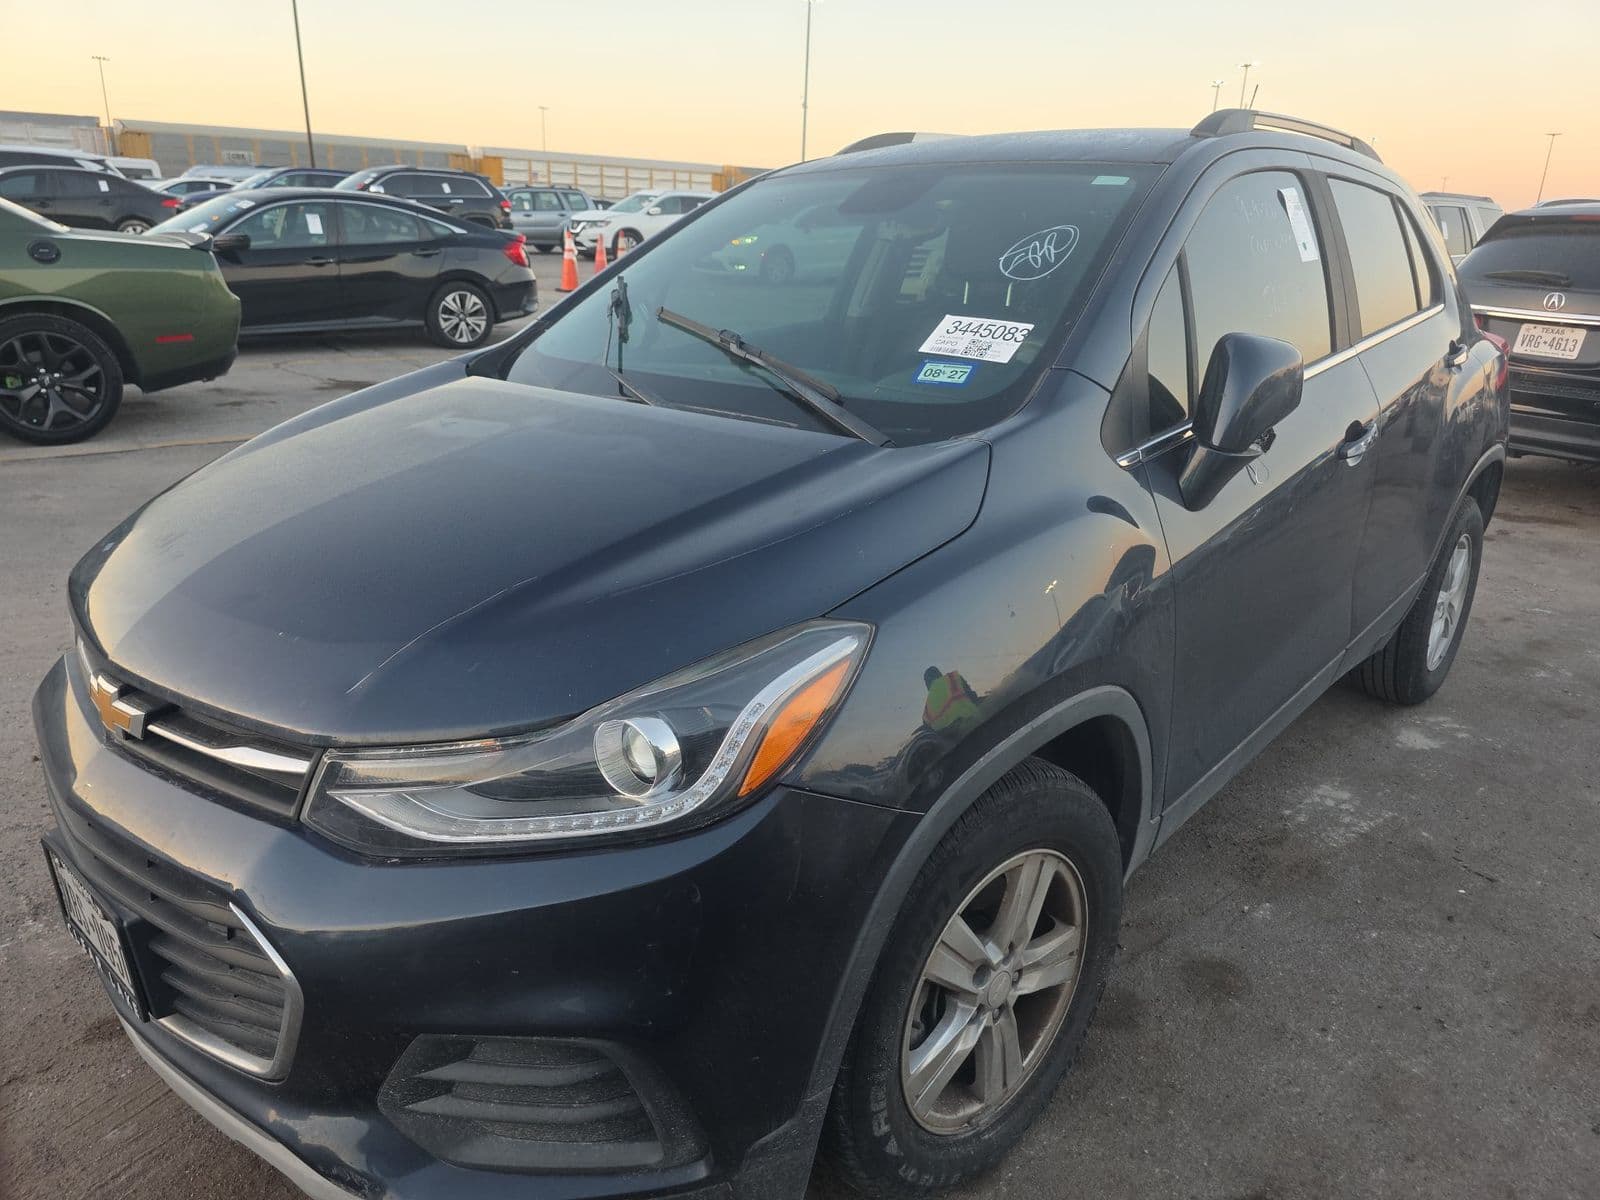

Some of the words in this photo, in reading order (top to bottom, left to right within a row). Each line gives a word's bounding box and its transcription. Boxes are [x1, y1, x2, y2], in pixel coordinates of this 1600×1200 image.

[946, 320, 1030, 343] 3445083
[1541, 327, 1566, 335] TEXAS
[924, 368, 941, 378] 08
[947, 369, 969, 380] 27
